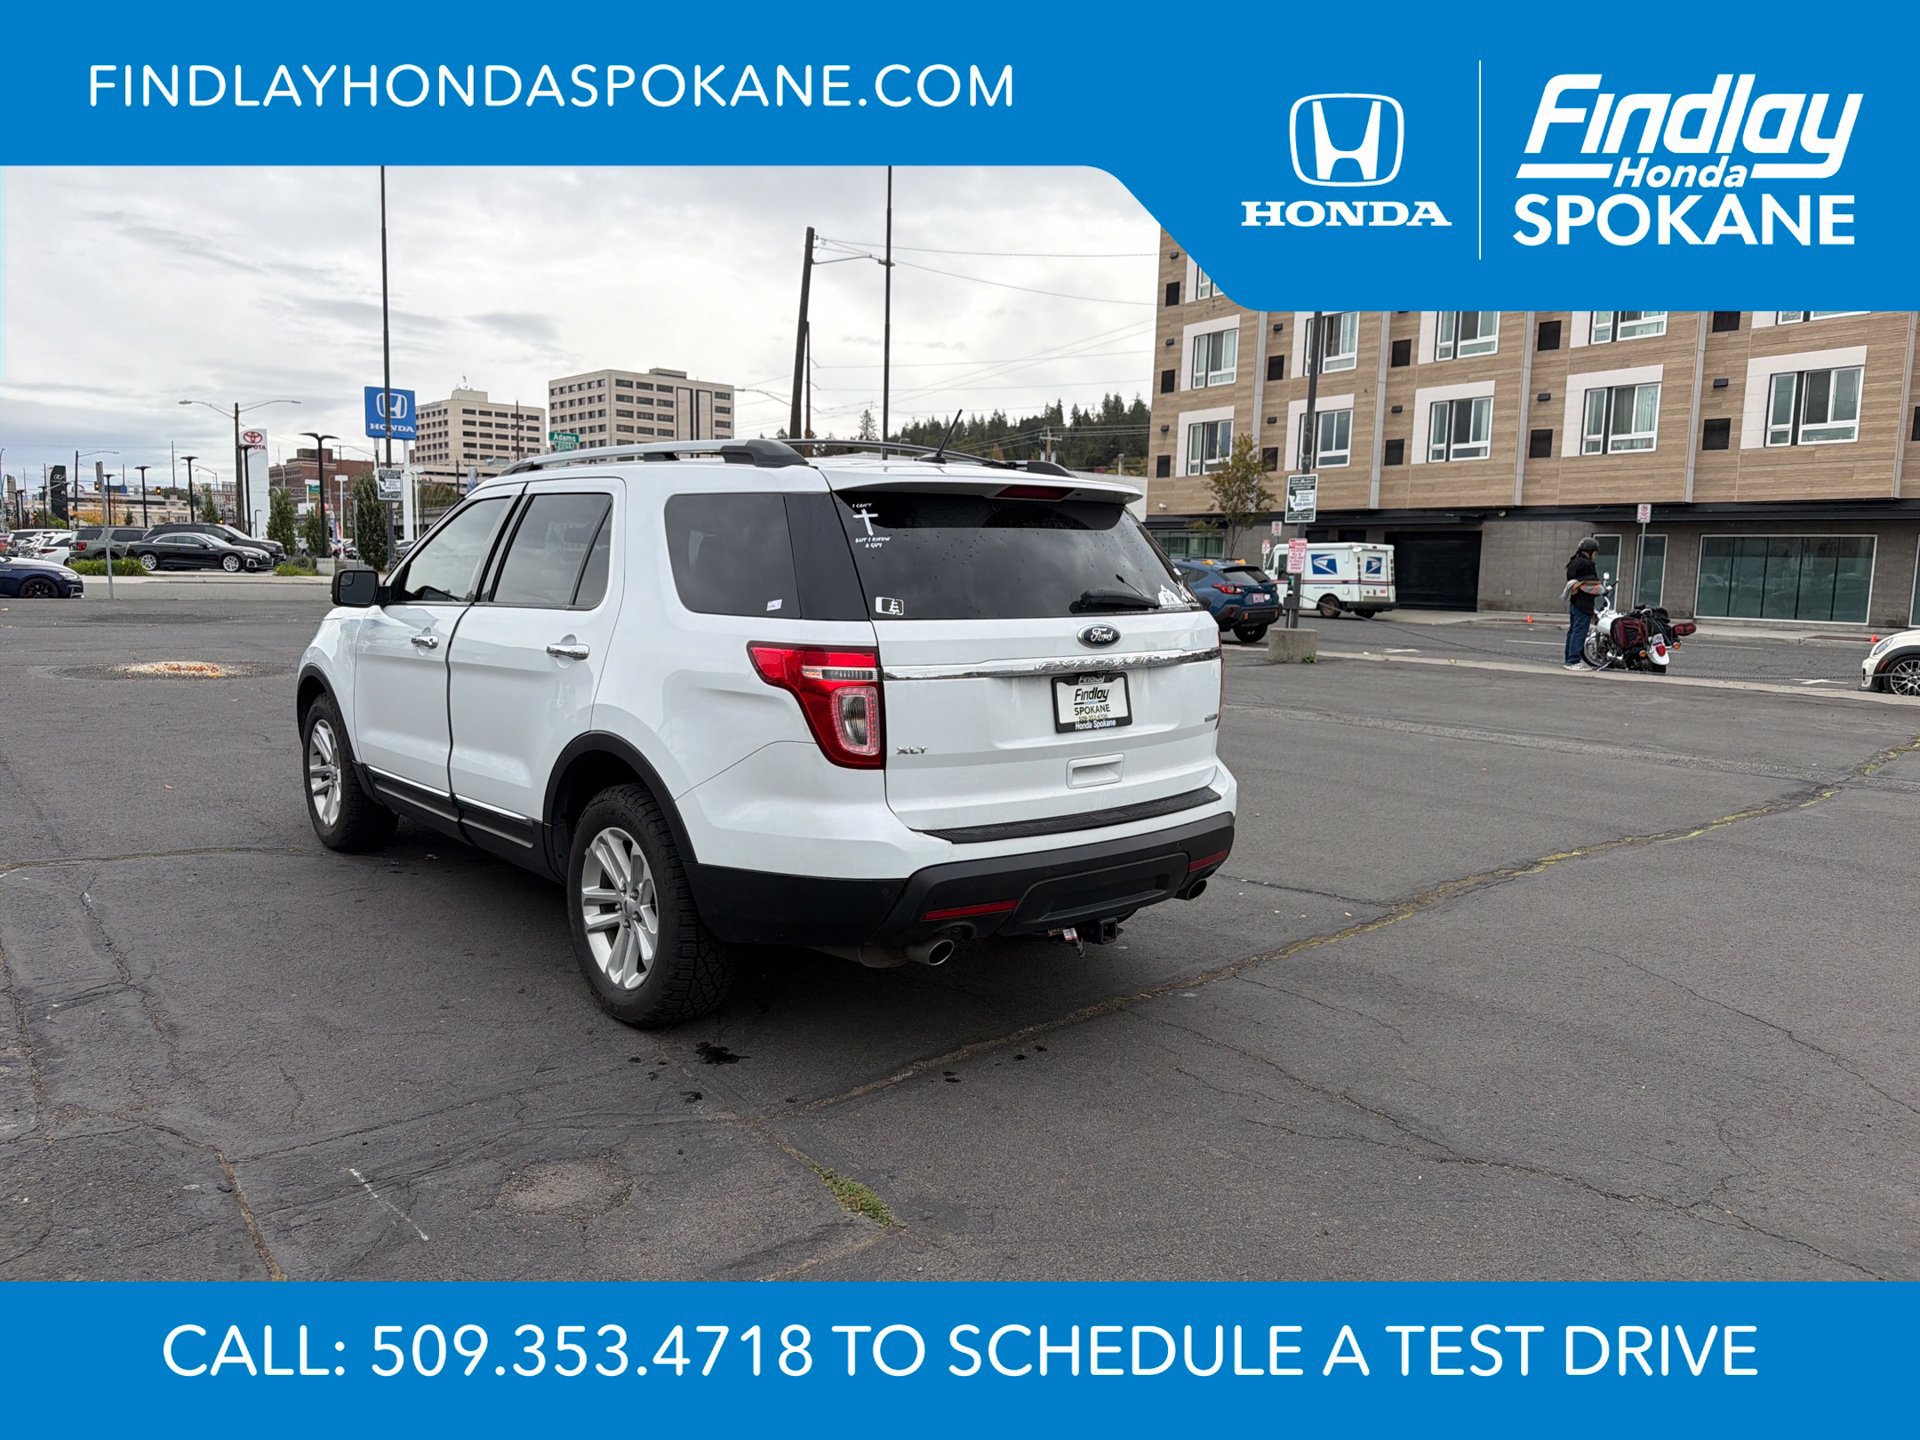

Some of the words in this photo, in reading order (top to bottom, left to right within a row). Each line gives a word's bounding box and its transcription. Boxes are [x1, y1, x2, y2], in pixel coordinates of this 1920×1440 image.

[553, 433, 577, 443] Adams
[1091, 628, 1113, 642] Ford
[1074, 687, 1109, 703] Findlay
[1074, 704, 1110, 715] SPOKANE
[1075, 720, 1092, 730] Honda
[1092, 719, 1117, 729] Spokane
[896, 746, 928, 755] XLT
